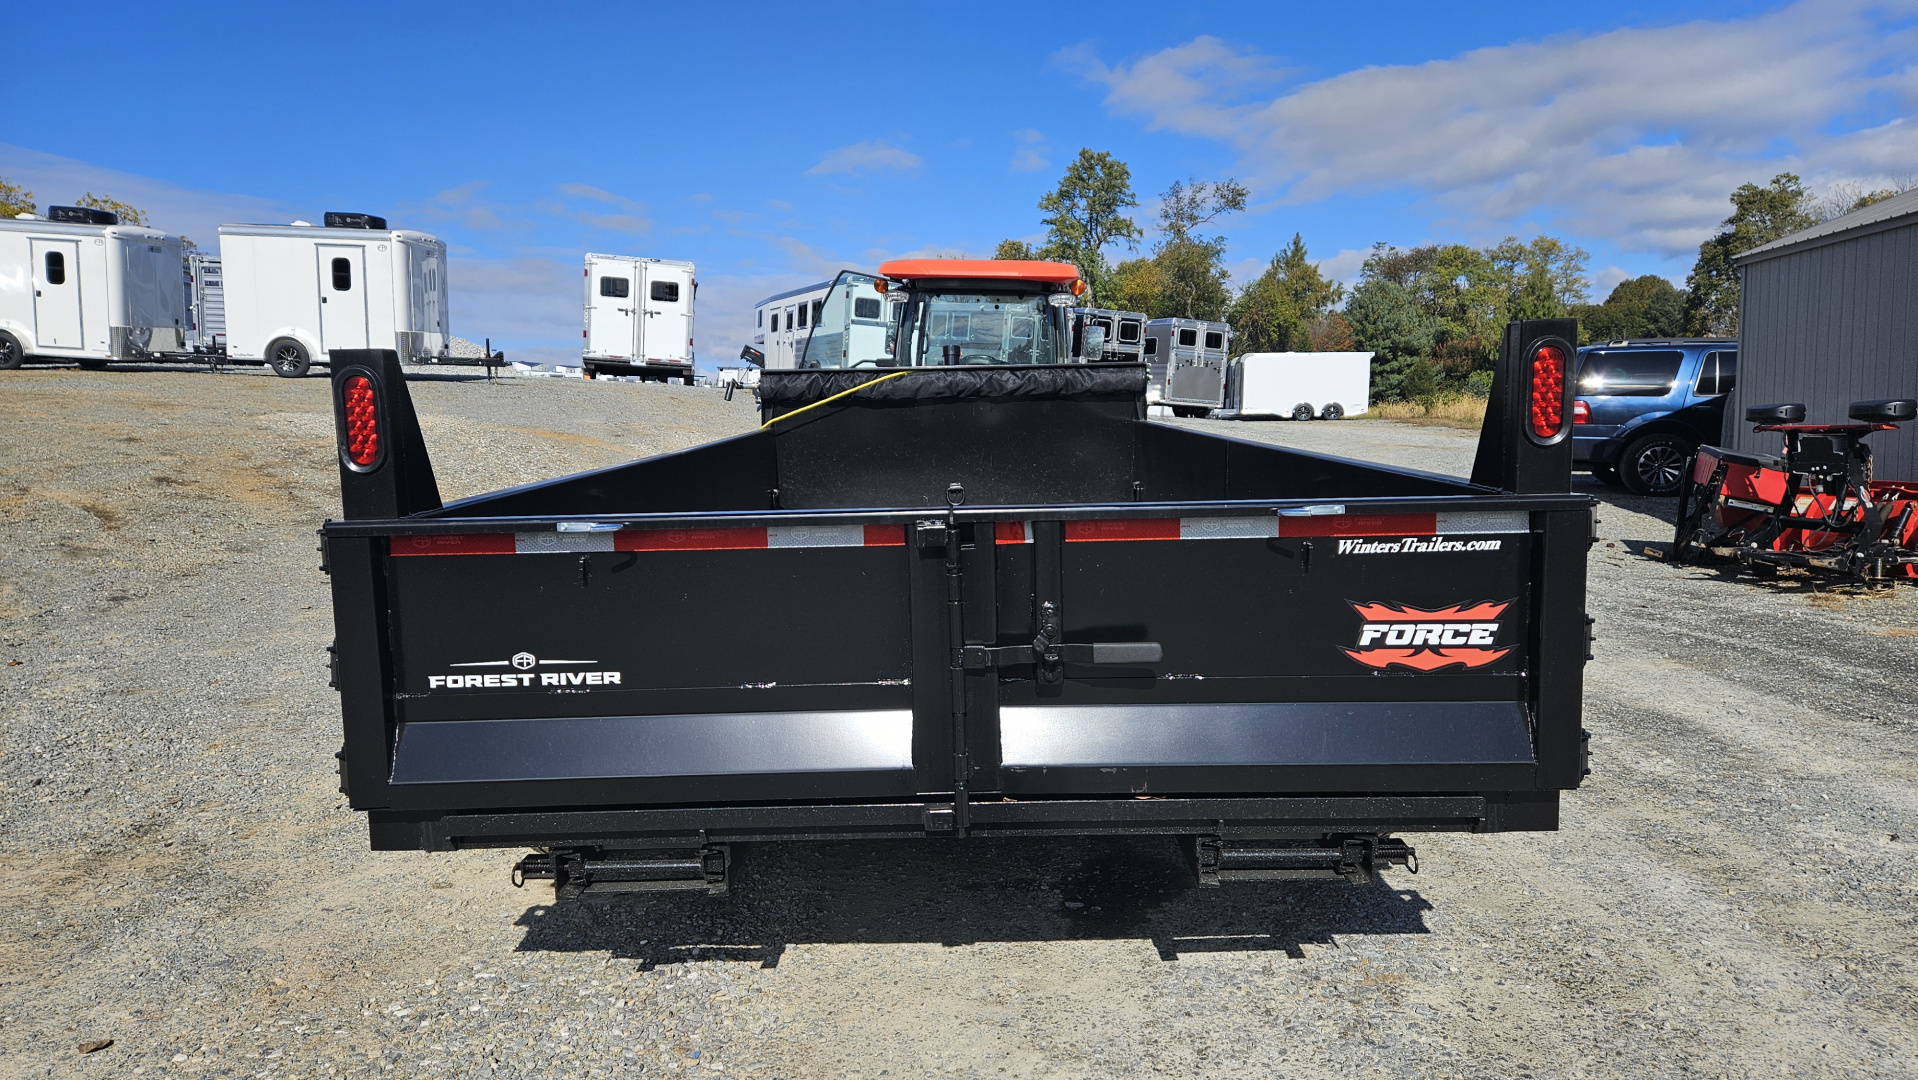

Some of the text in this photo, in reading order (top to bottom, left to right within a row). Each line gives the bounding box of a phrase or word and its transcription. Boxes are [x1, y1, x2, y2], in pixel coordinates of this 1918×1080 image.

[1338, 537, 1501, 554] WintersTrailers.com
[1359, 624, 1499, 645] FORCE
[428, 672, 621, 688] FOREST RIVER
